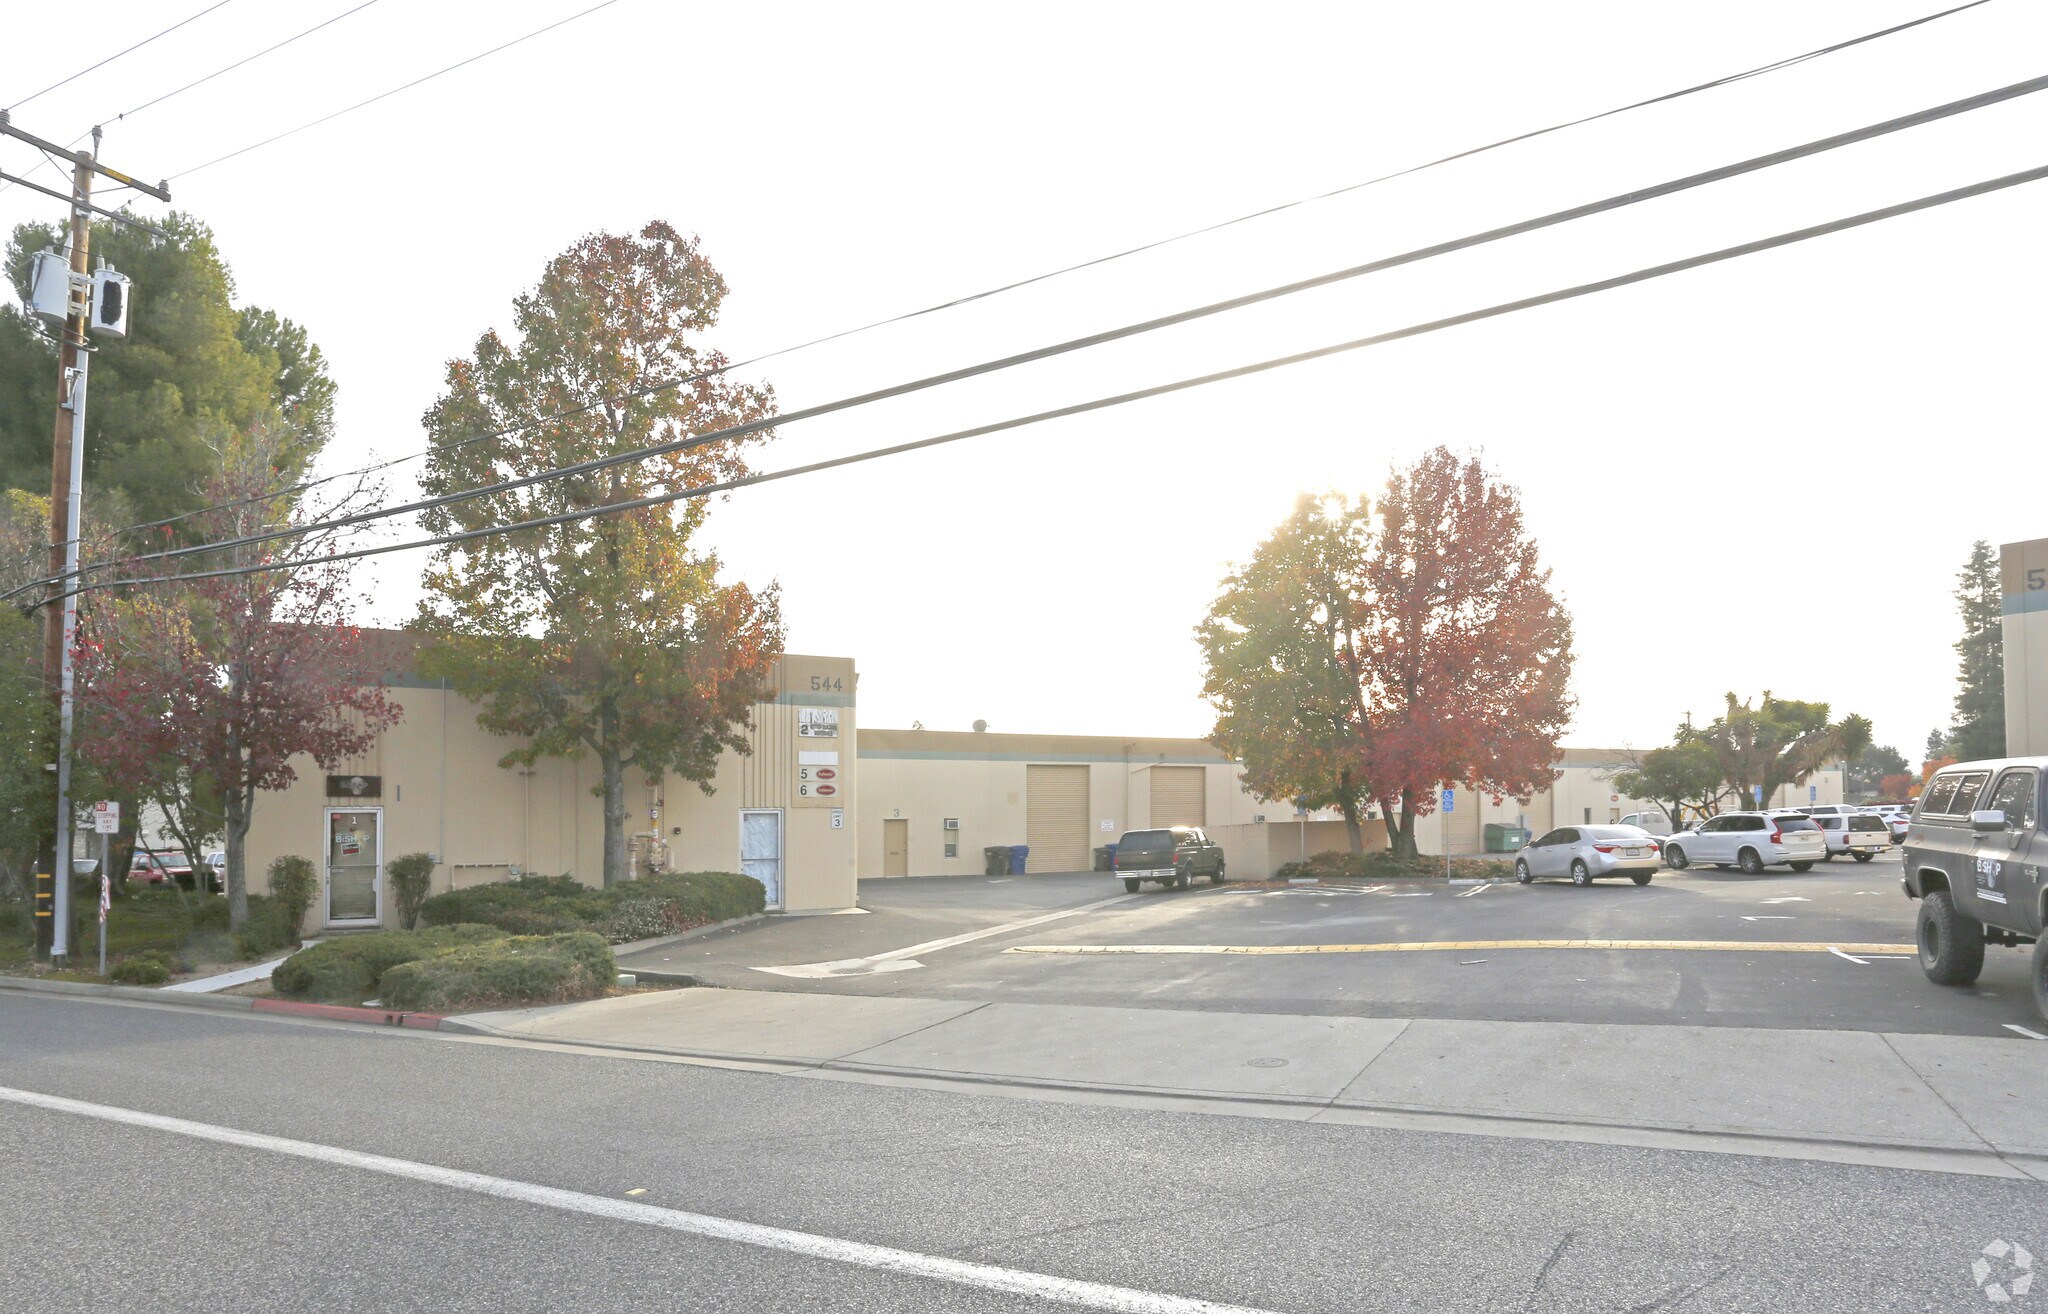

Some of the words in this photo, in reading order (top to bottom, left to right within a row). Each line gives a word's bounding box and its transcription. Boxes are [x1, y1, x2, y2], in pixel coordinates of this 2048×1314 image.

[811, 676, 842, 691] 544
[800, 724, 809, 735] 2
[800, 768, 808, 780] 5
[800, 784, 808, 796] 6
[893, 808, 900, 818] 3
[352, 816, 357, 824] 1
[834, 818, 841, 827] 3
